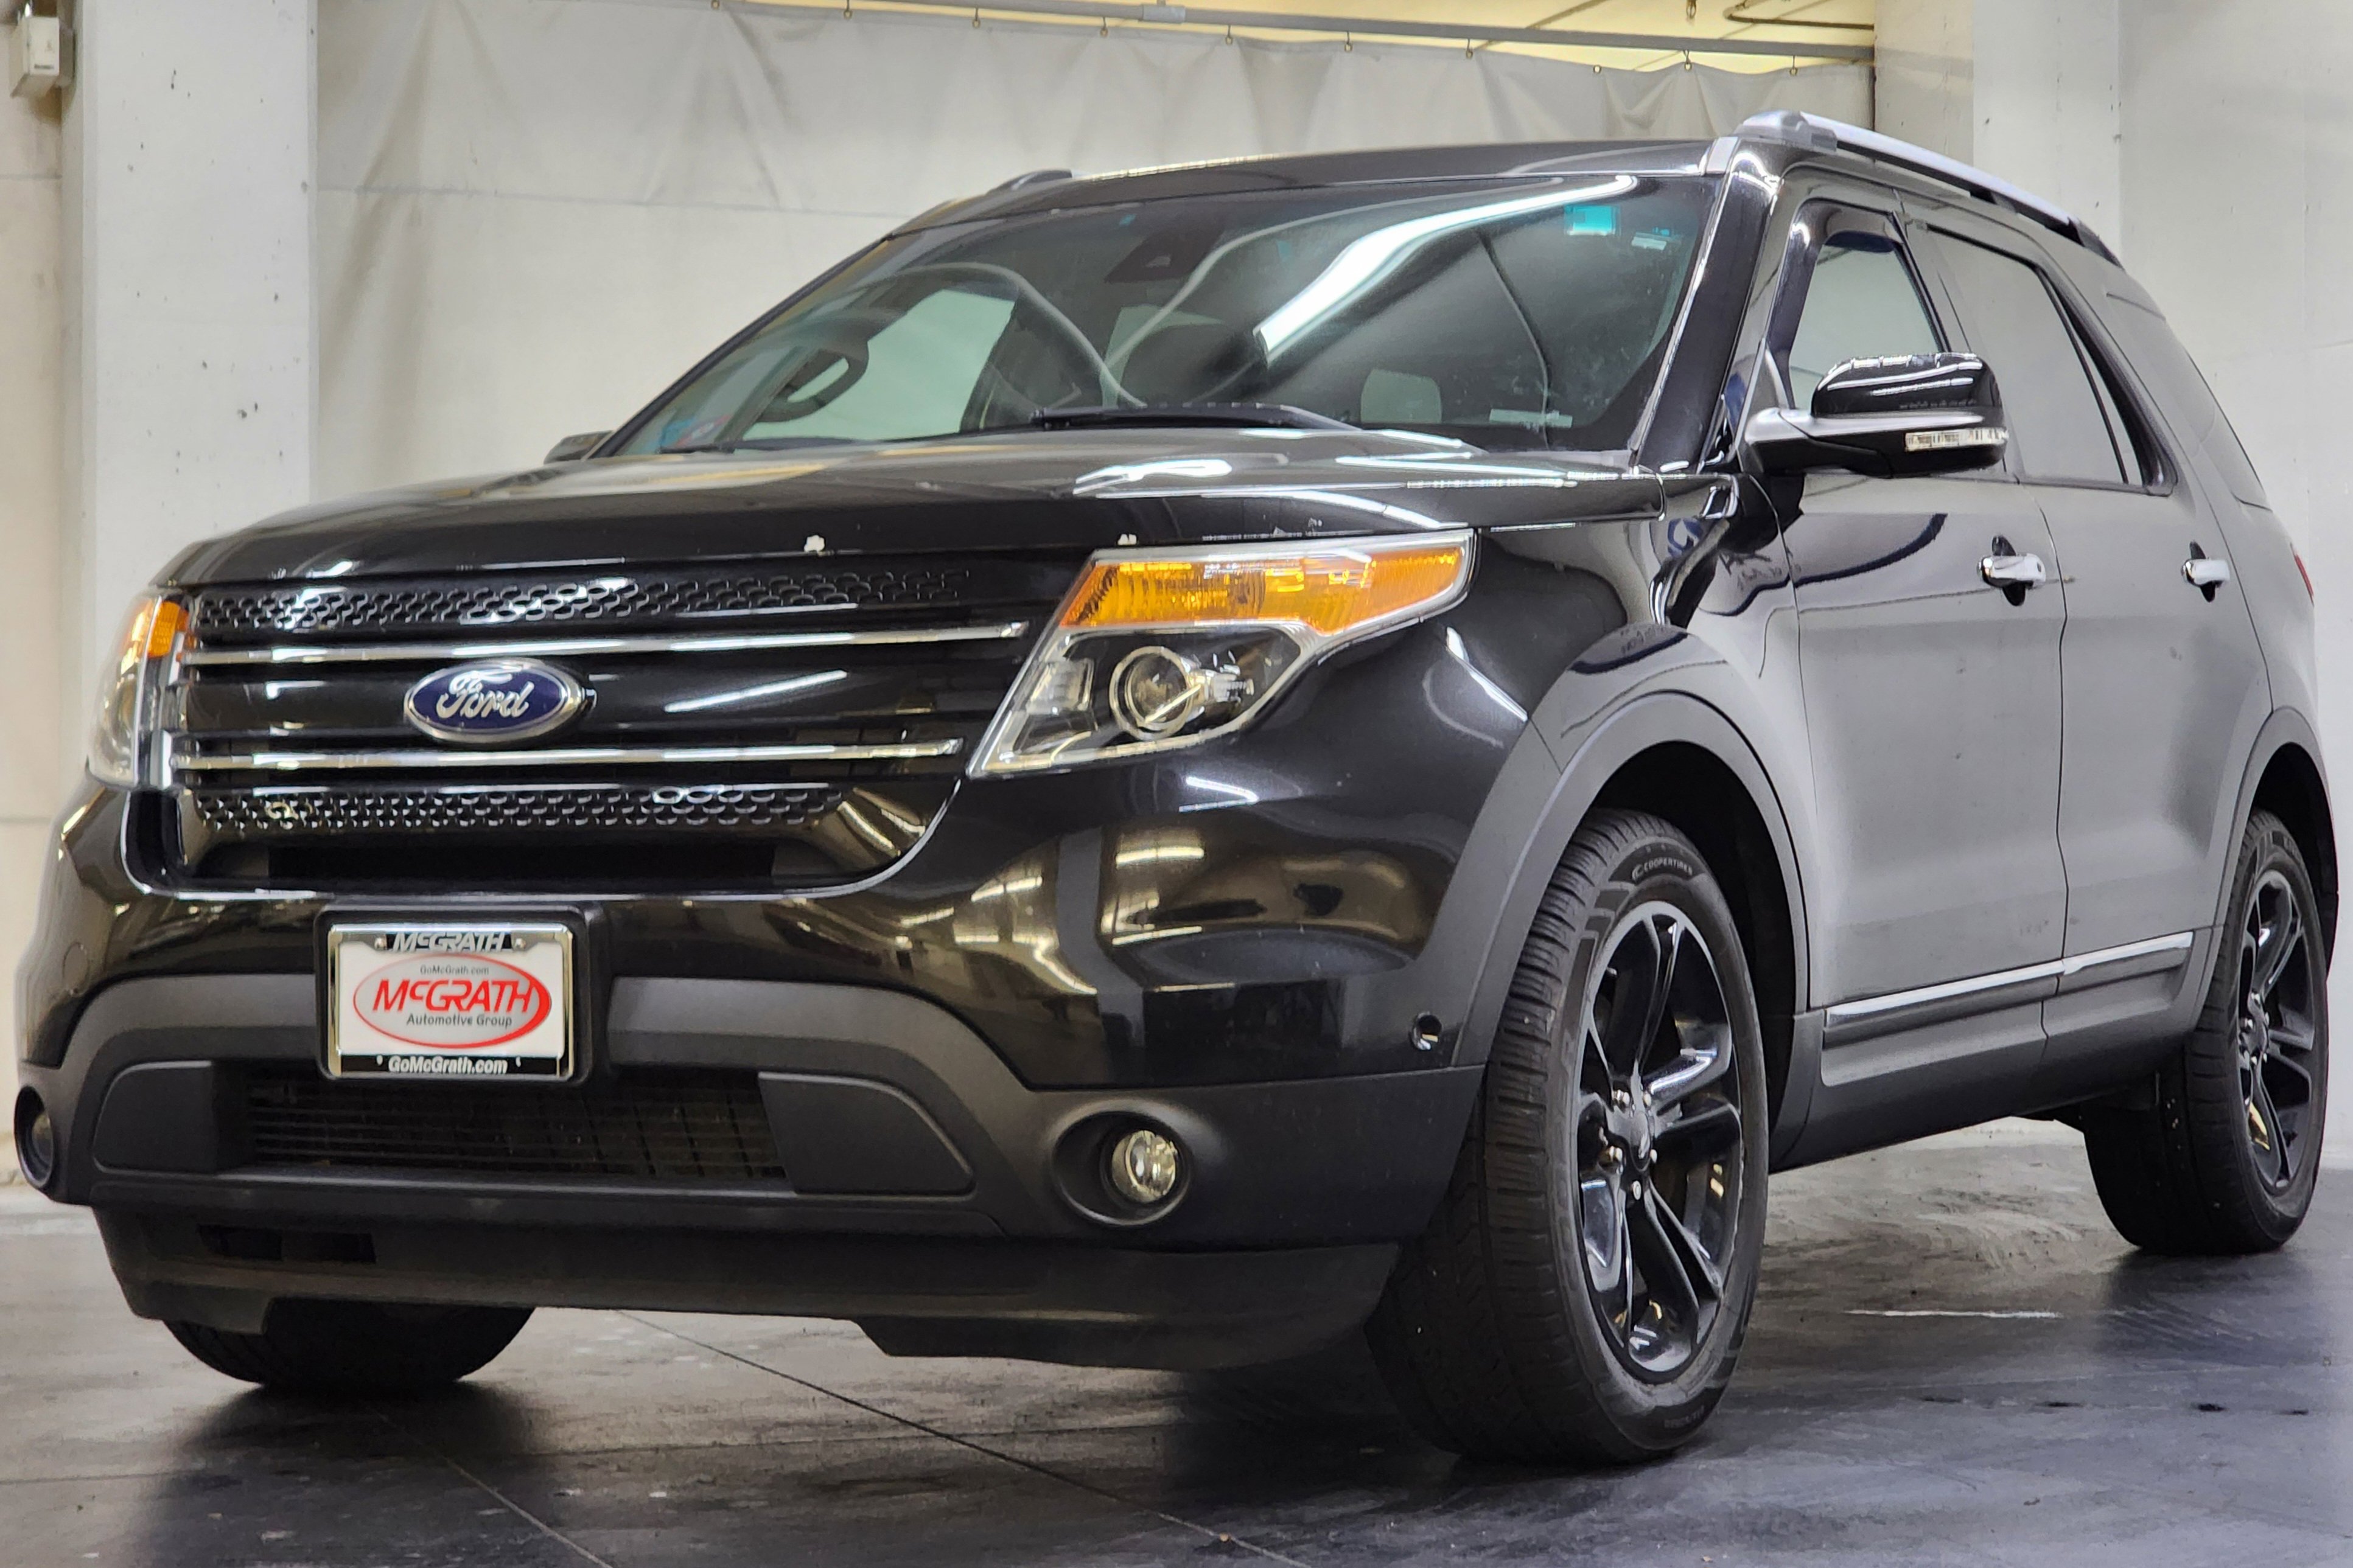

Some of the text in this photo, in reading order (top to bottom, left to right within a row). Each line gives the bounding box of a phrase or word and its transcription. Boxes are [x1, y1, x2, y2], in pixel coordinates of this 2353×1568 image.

[436, 671, 534, 719] Ford
[420, 964, 489, 975] GoMcGrath.com
[407, 1013, 512, 1029] Automotive Group
[388, 1056, 508, 1075] GoMcGrath.com
